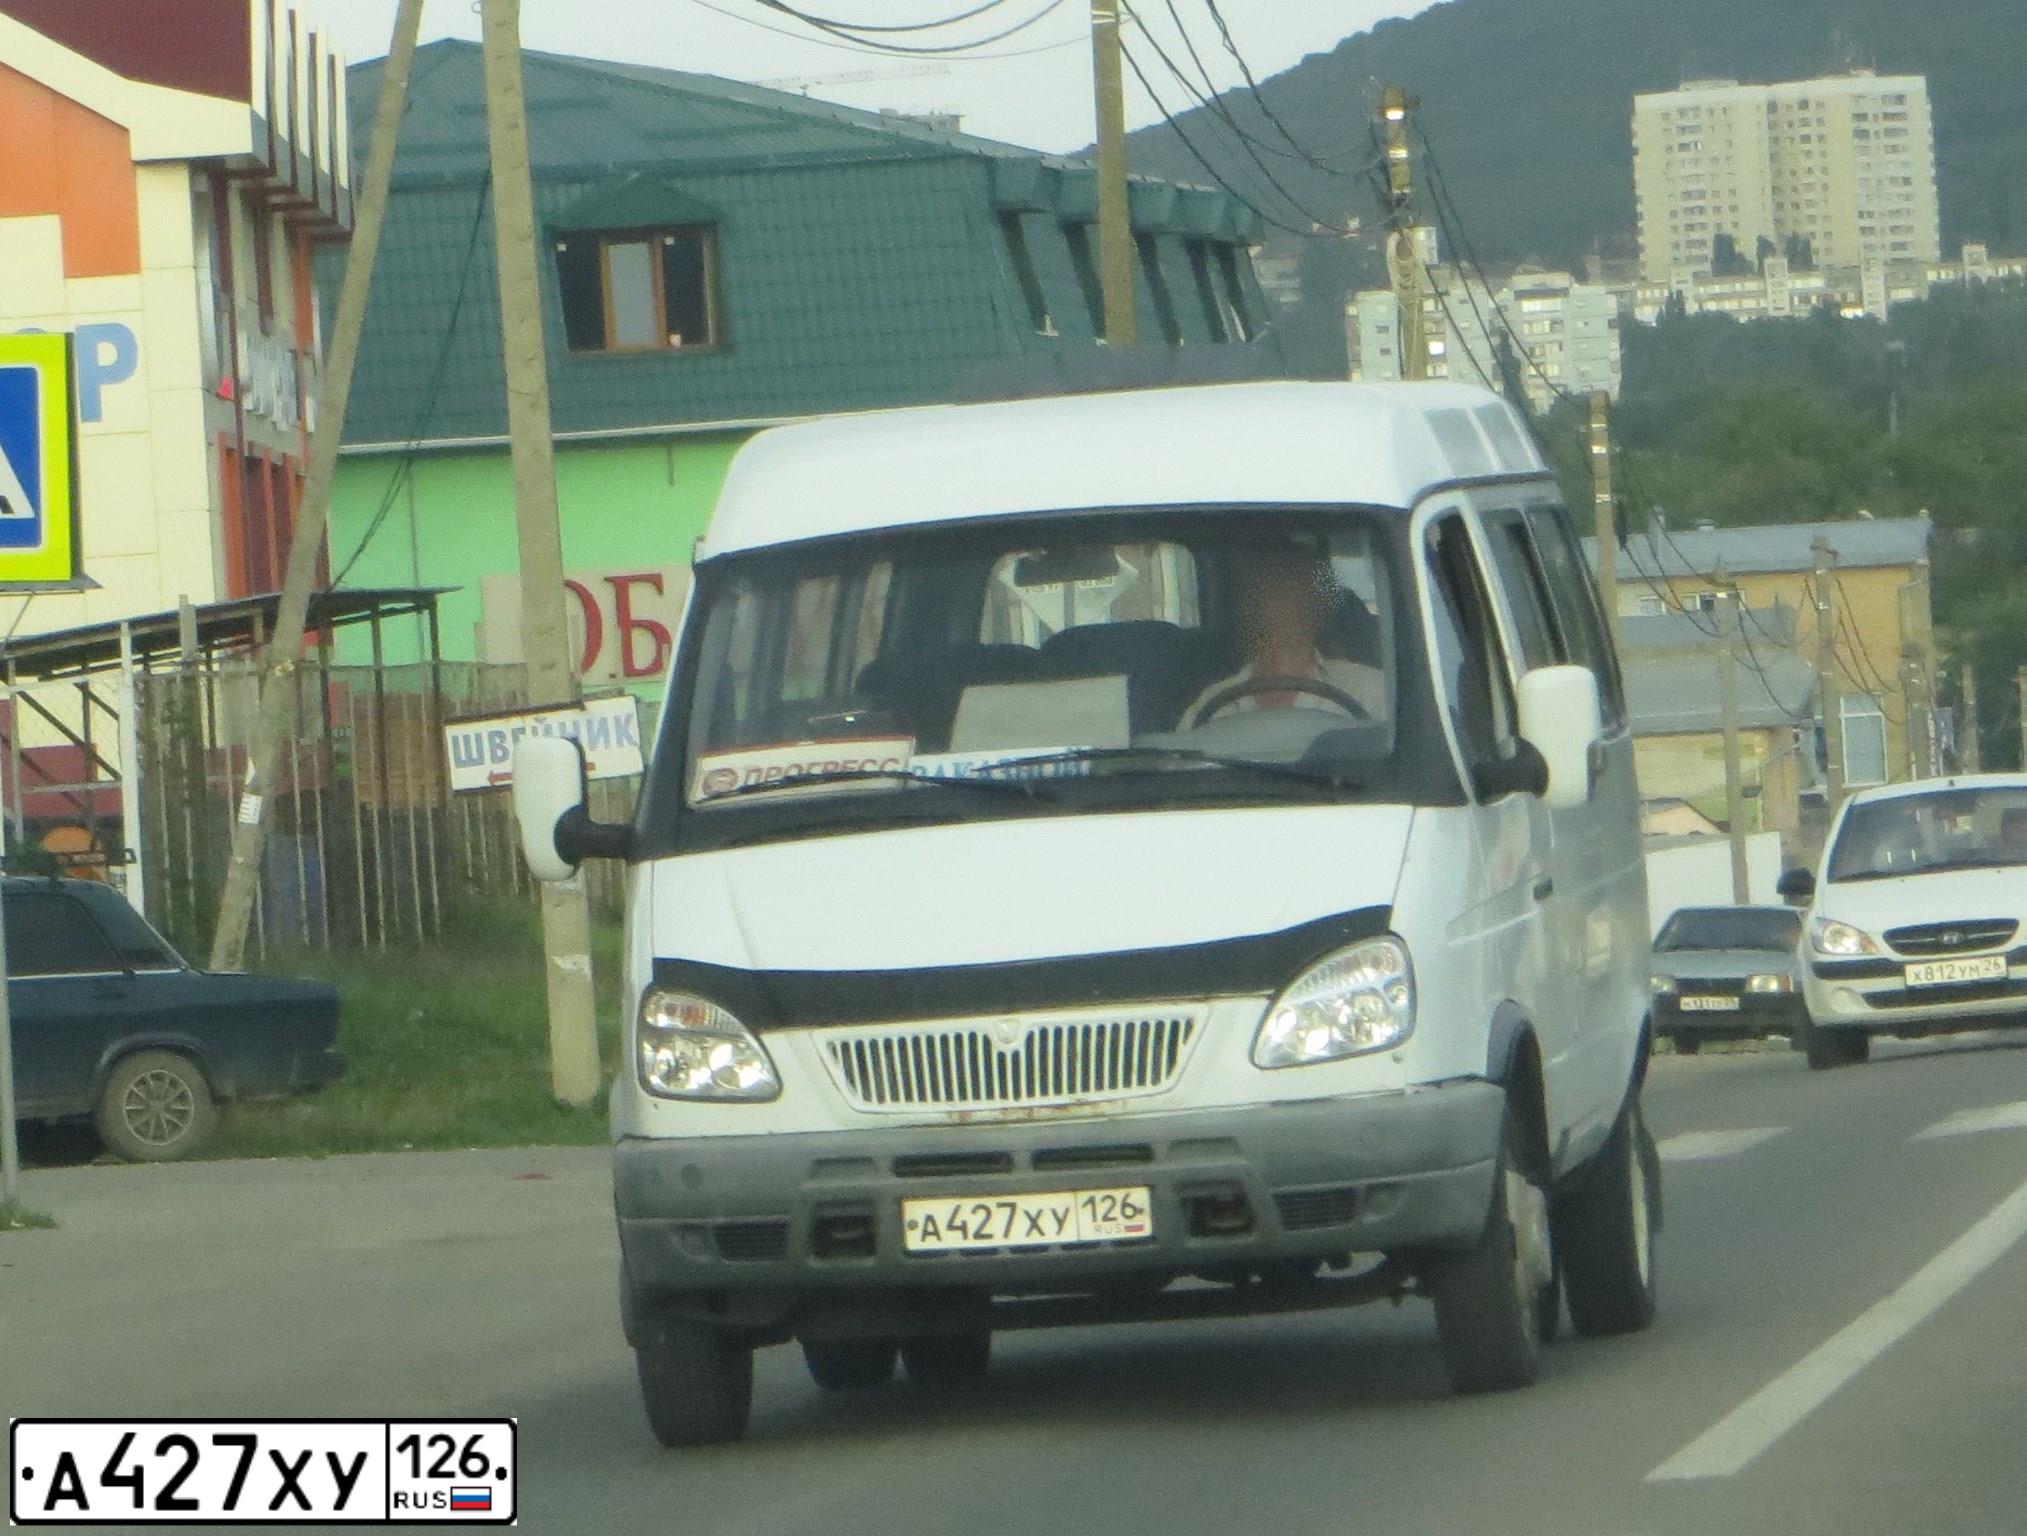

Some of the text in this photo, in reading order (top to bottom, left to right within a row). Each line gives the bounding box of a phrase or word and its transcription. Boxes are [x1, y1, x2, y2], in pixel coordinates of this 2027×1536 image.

[745, 757, 900, 785] ПРОГРЕСС
[921, 1194, 1137, 1242] А427ХУ 126
